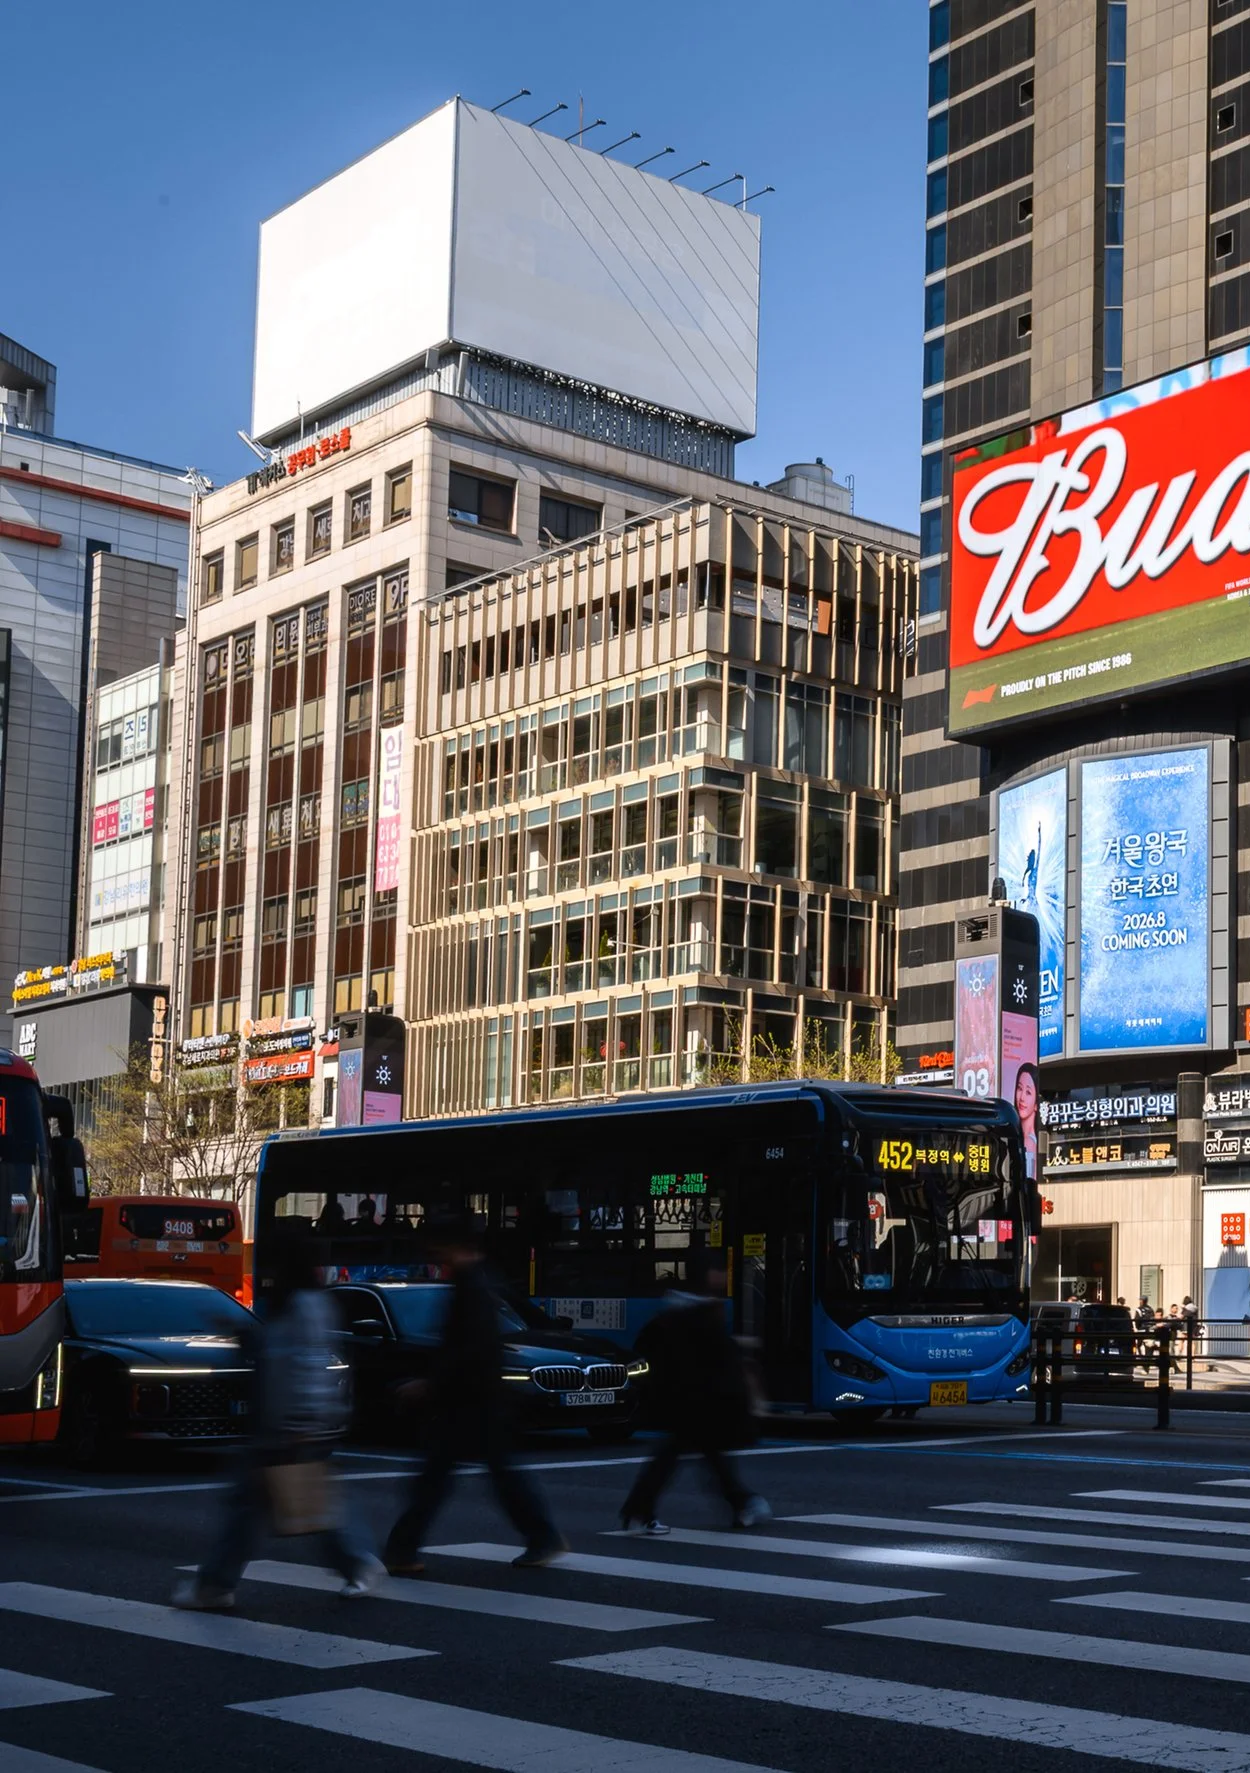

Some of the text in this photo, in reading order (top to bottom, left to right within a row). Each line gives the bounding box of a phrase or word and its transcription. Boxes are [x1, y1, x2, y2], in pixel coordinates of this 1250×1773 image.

[1001, 653, 1132, 698] PROUDLY ON THE PITCH SINCE 1986
[1101, 829, 1188, 867] 겨울왕국
[1123, 911, 1166, 931] 2026.8
[1101, 928, 1187, 951] COMING SOON
[20, 1023, 37, 1044] ABC
[19, 1042, 36, 1056] MART
[963, 1068, 990, 1097] 03
[765, 1147, 785, 1160] 6454
[968, 1144, 990, 1159] 중대
[1206, 1141, 1237, 1153] ON AIR
[878, 1141, 912, 1170] 452
[915, 1149, 950, 1164] 복정역
[969, 1158, 990, 1173] 병원
[164, 1220, 194, 1235] 9408
[931, 1317, 964, 1325] HIGER
